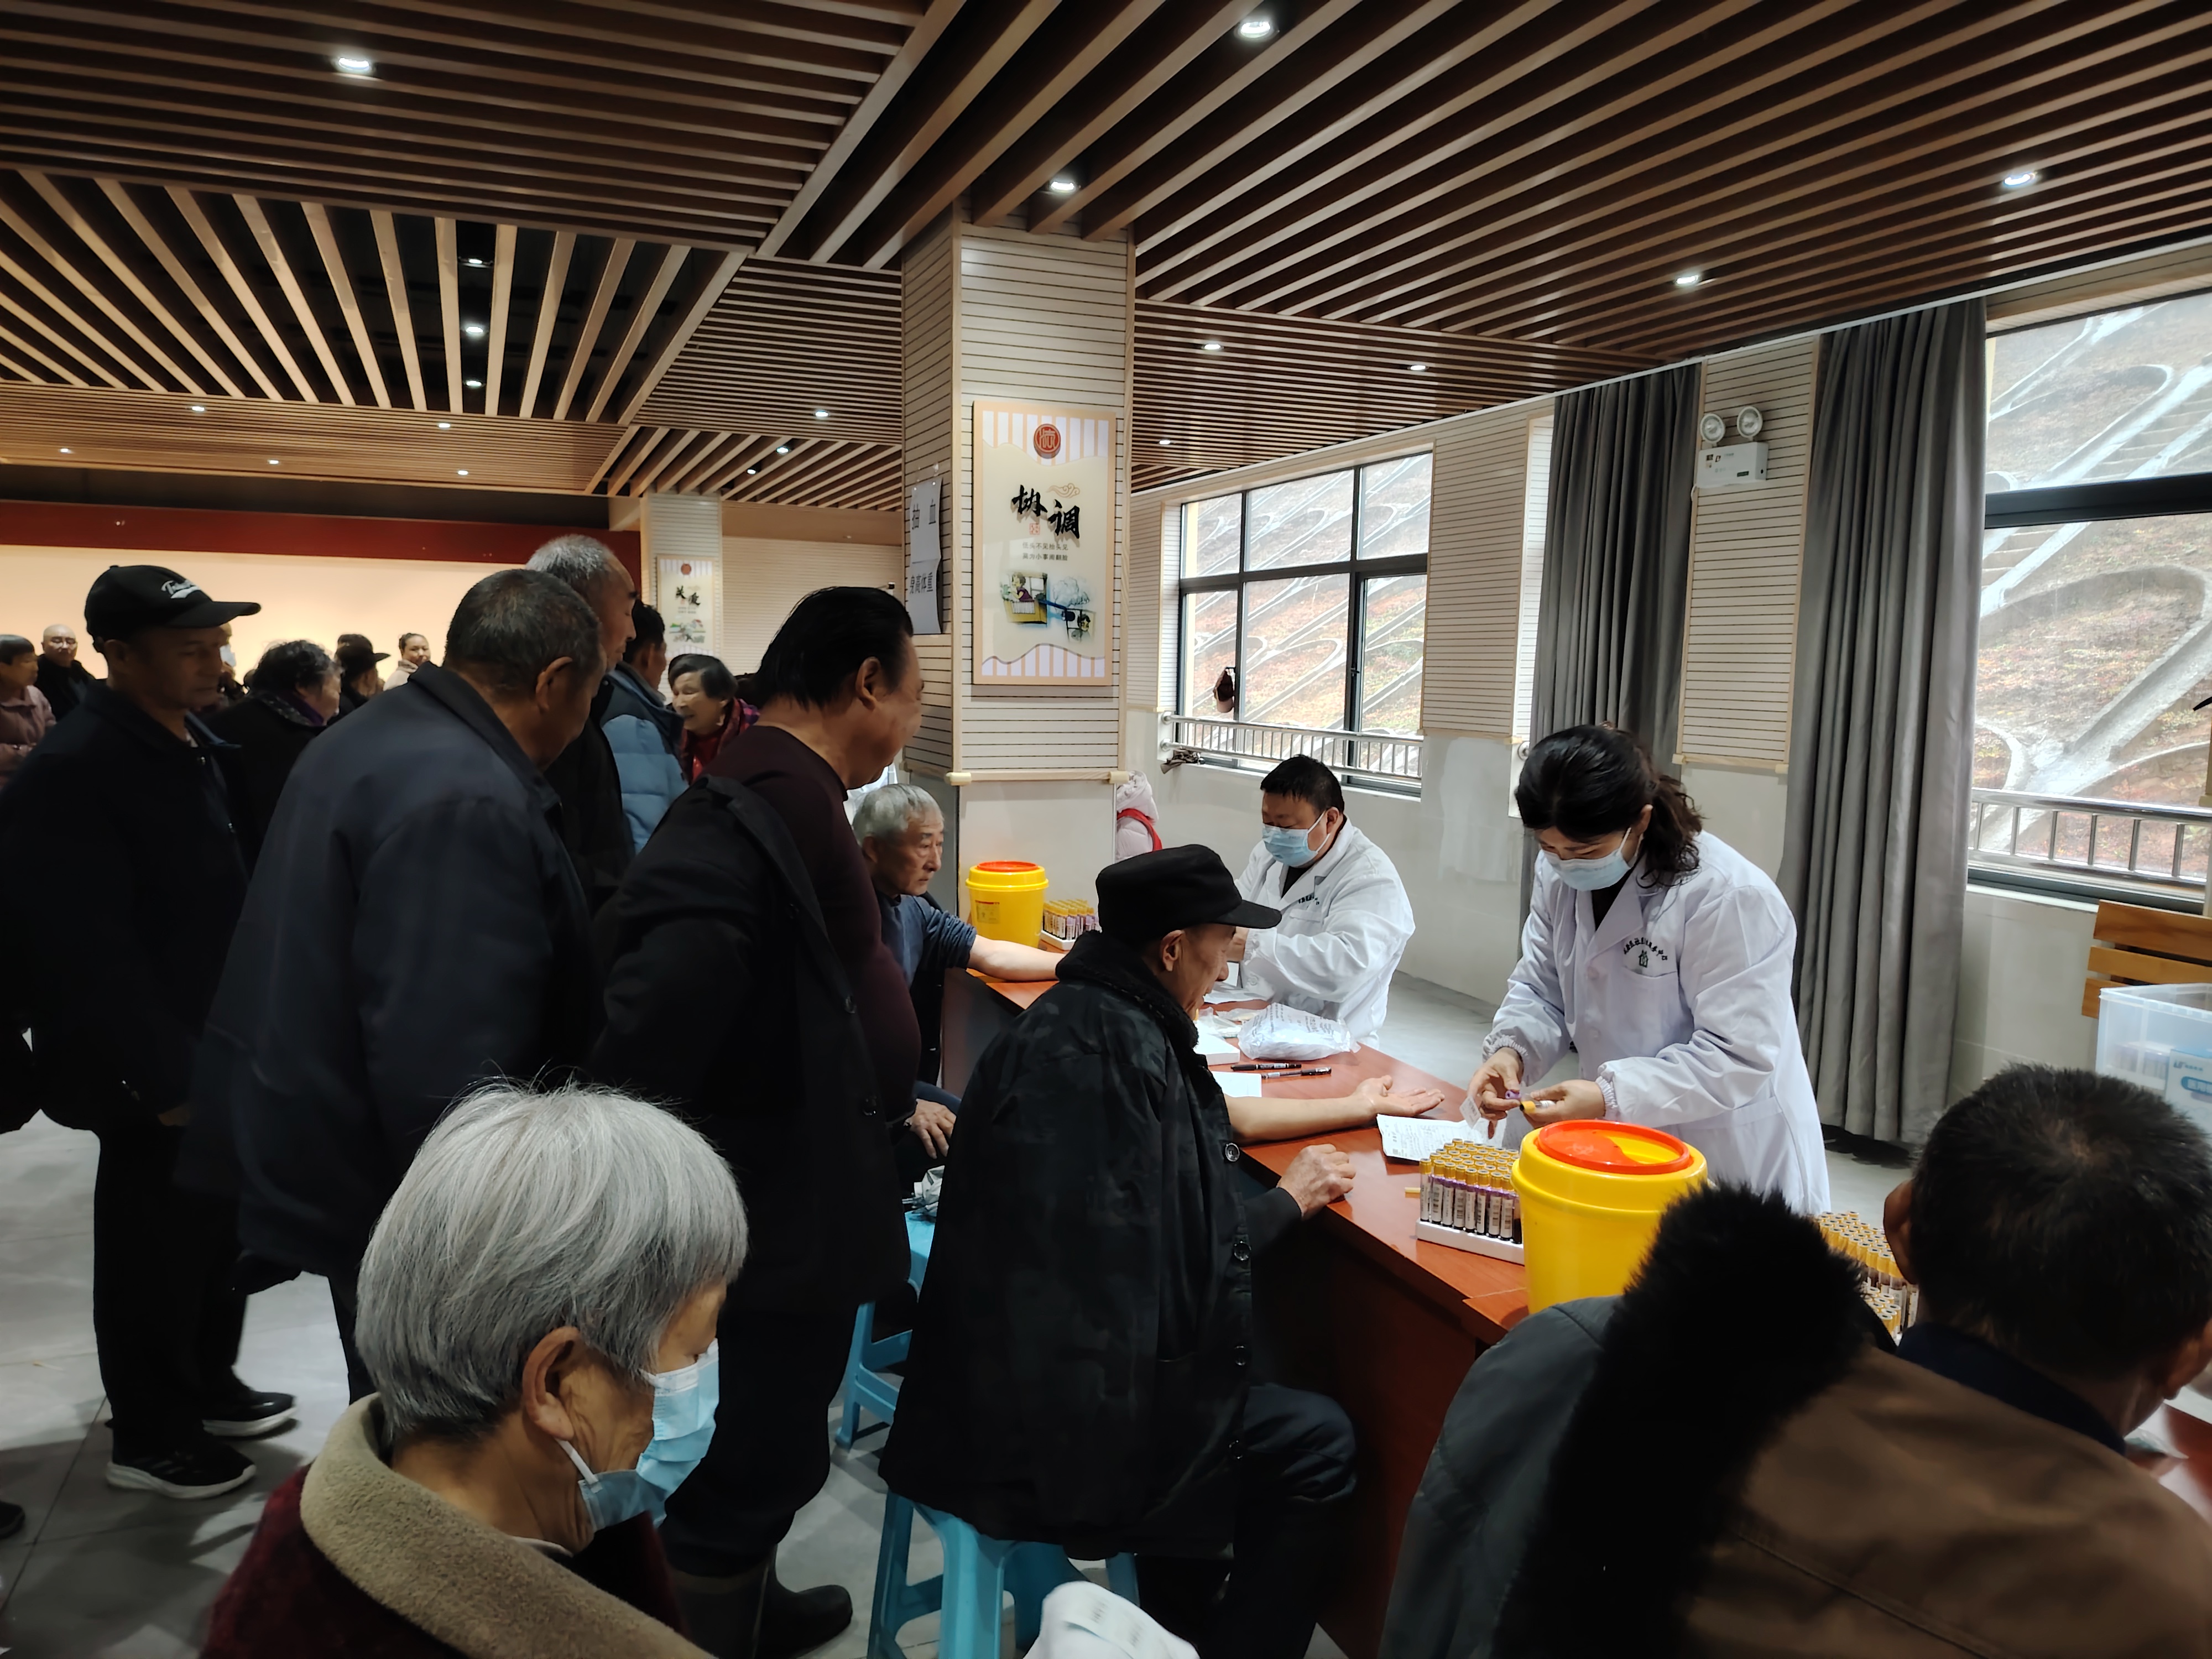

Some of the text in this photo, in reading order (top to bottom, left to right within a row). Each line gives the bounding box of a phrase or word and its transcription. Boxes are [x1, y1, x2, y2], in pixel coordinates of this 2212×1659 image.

[1011, 484, 1079, 539] 协调
[910, 572, 933, 594] 身高体重
